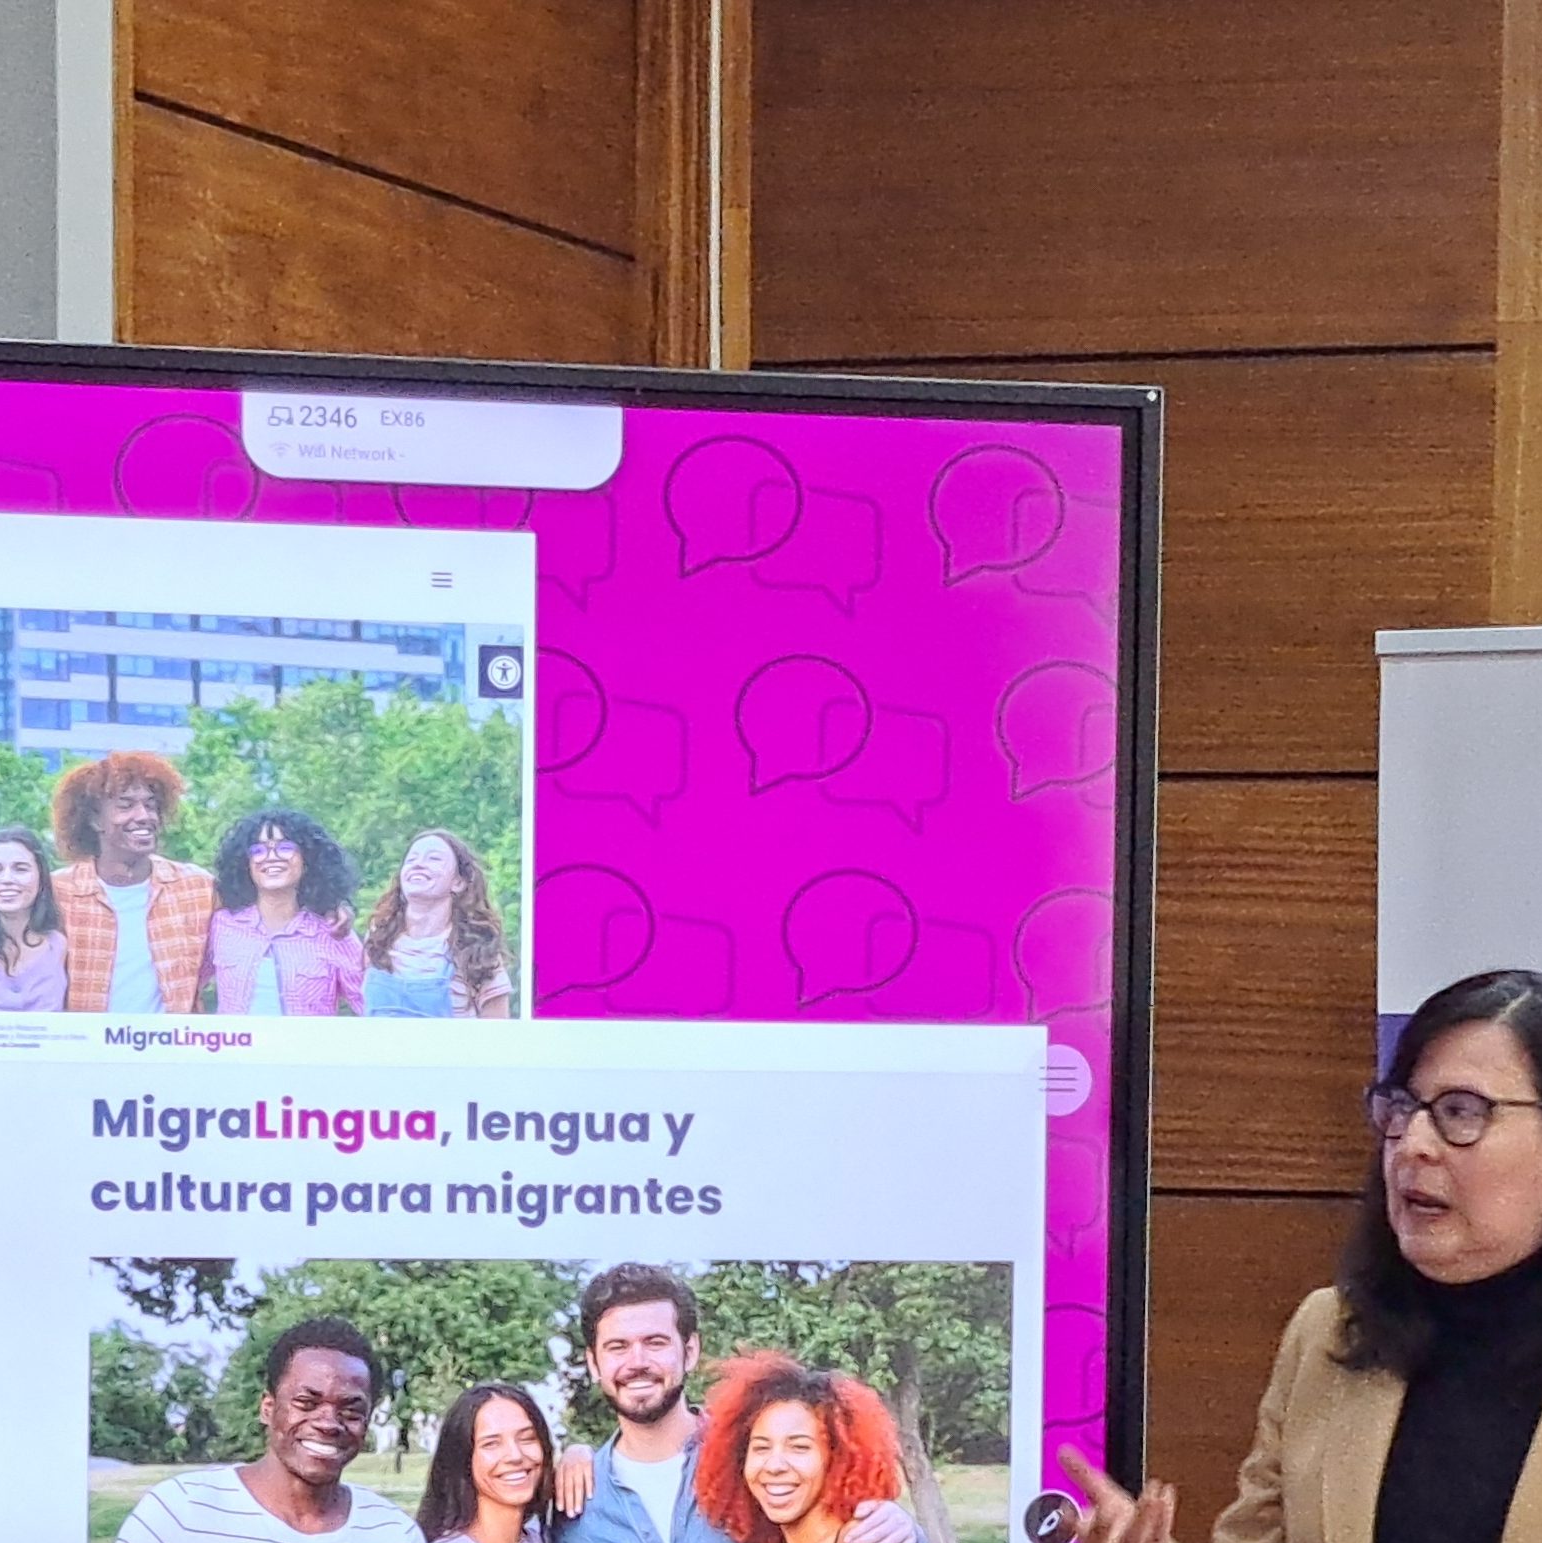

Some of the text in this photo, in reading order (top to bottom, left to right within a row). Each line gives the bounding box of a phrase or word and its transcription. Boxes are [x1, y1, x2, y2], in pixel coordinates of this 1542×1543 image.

[299, 405, 426, 428] 2346 EX86
[331, 445, 396, 461] Network
[105, 1026, 252, 1052] MigraLingua
[92, 1094, 695, 1156] MigraLingua, lengua y
[90, 1171, 723, 1228] cultura para migrantes
